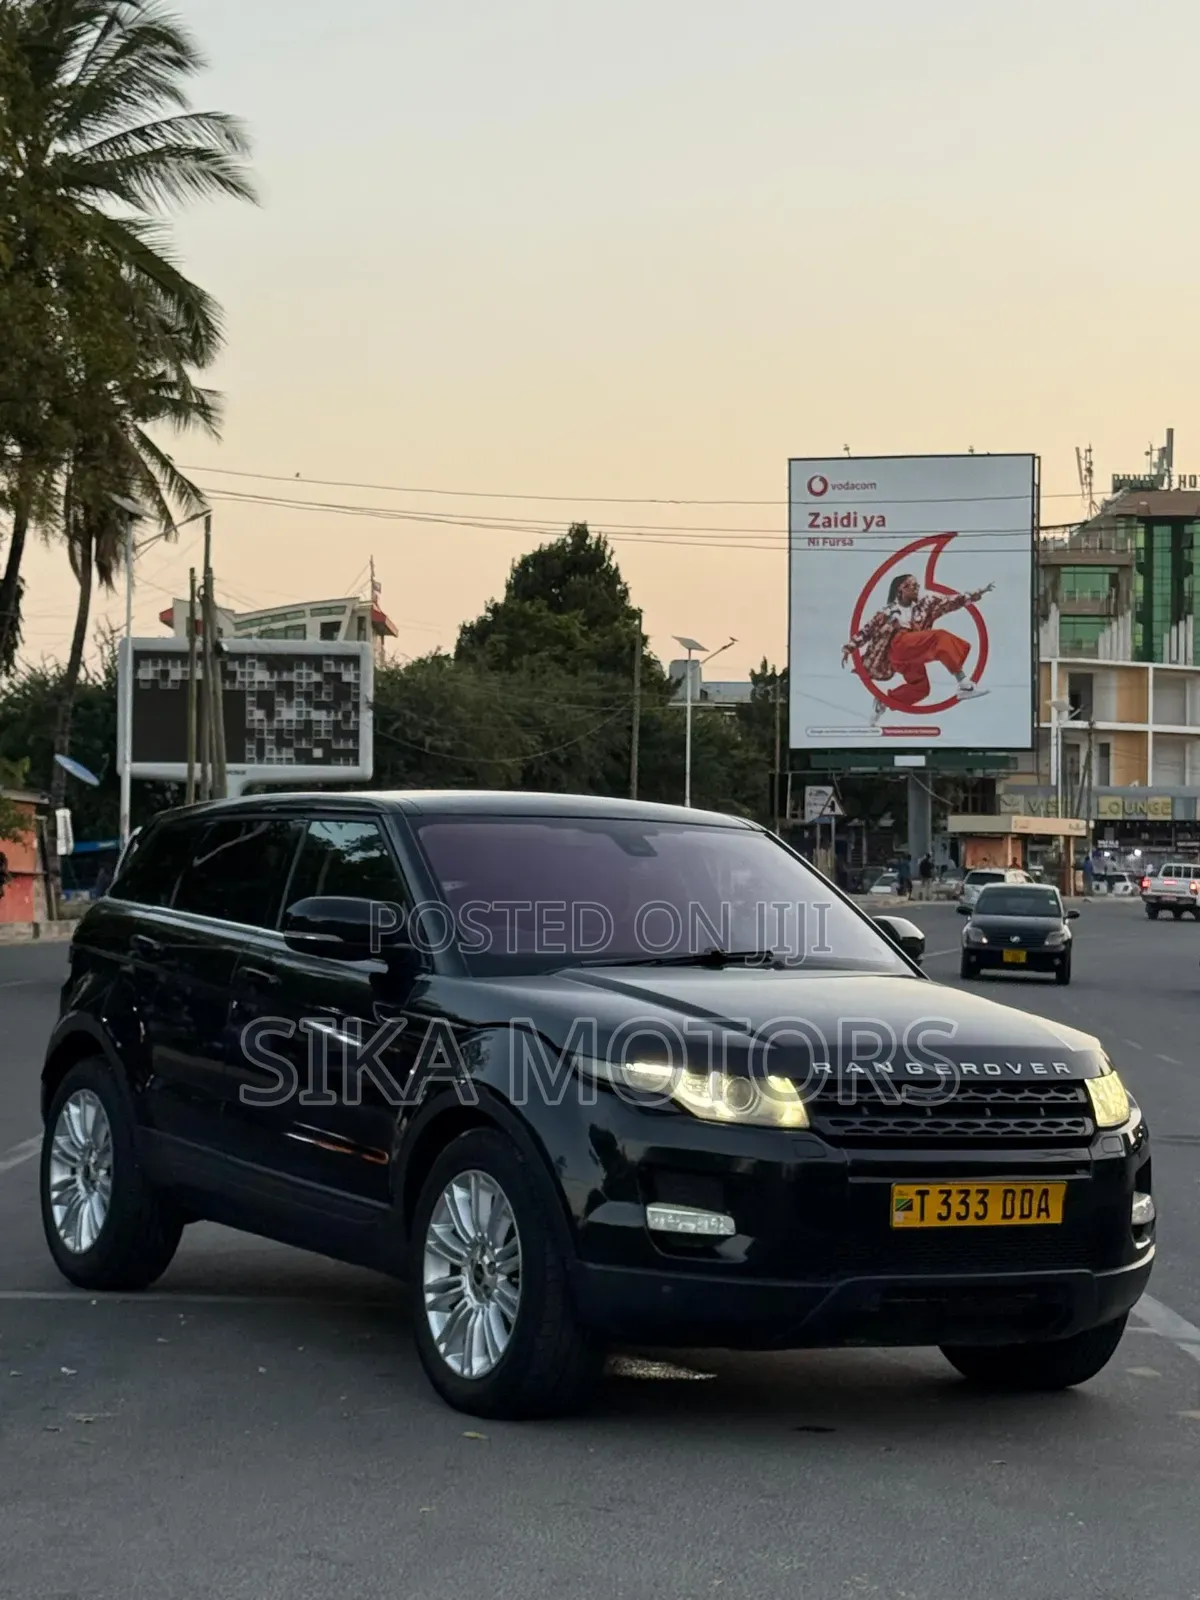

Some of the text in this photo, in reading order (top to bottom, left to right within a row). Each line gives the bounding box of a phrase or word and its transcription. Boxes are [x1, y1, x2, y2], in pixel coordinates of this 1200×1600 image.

[831, 481, 877, 491] vodacom
[1178, 474, 1200, 488] HO
[808, 511, 886, 533] Zaidi ya
[807, 536, 854, 547] Ni Fursa
[1099, 801, 1172, 817] LOUNGE
[915, 1188, 1051, 1222] T 333 DDA
